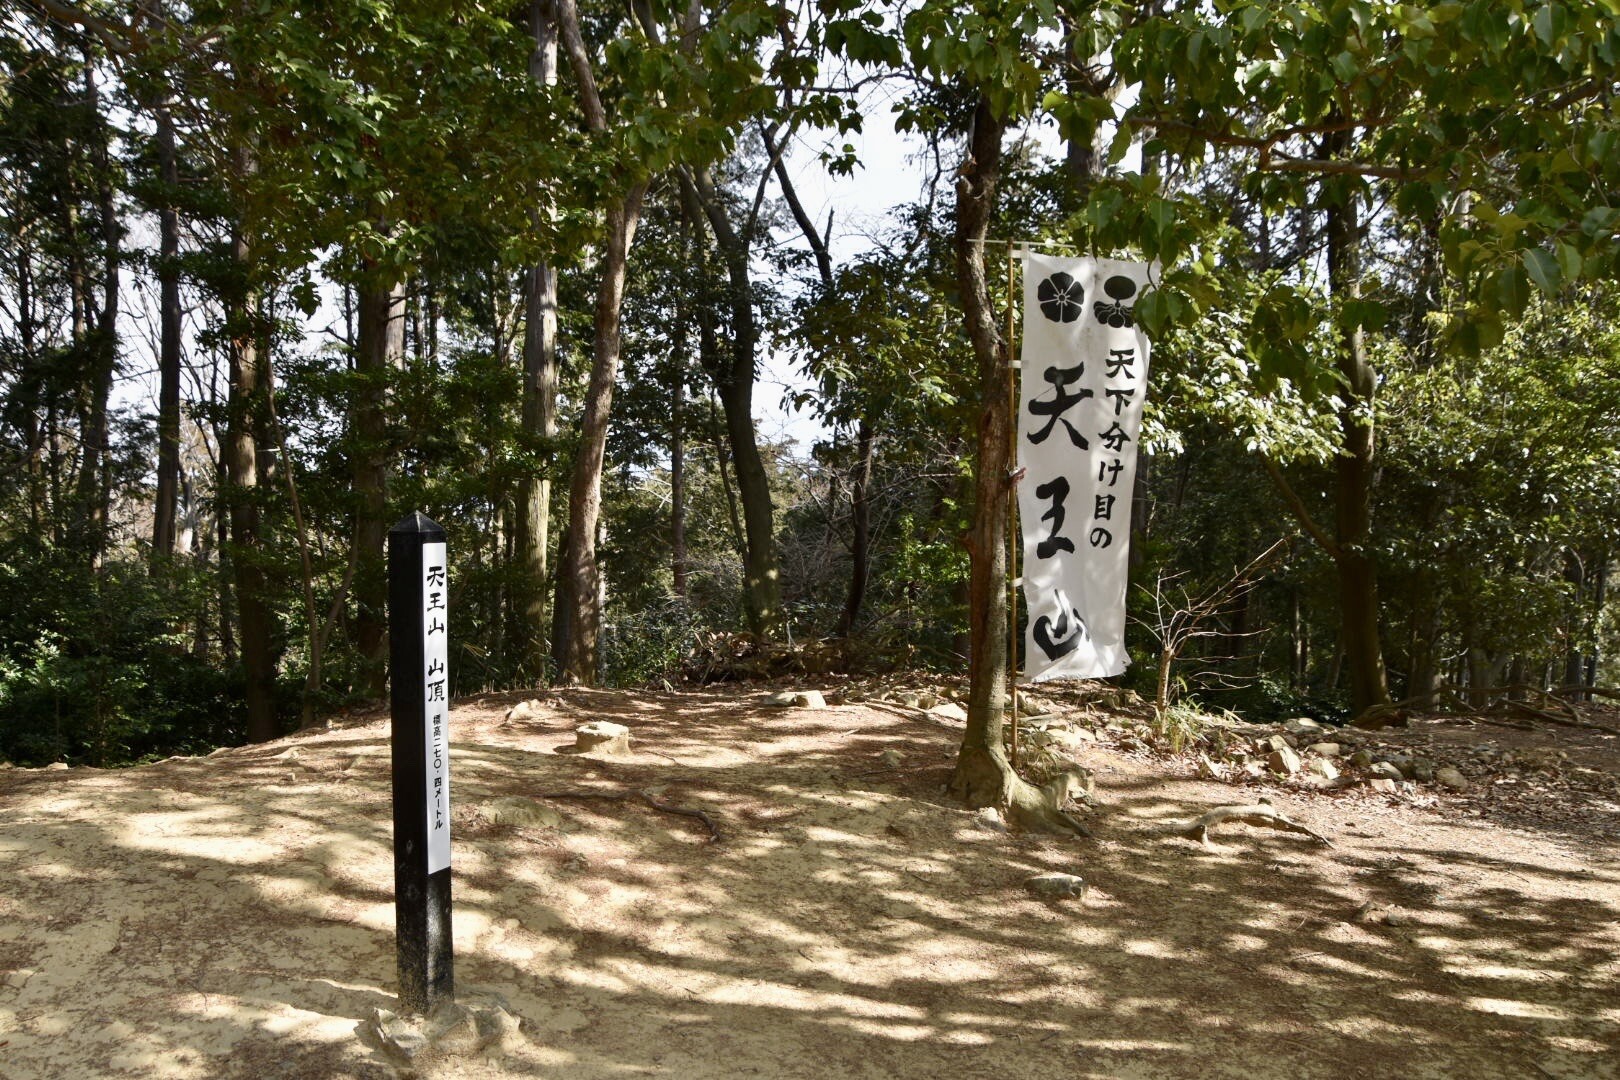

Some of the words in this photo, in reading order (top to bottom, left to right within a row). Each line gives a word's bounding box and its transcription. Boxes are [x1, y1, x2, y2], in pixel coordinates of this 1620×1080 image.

[1026, 361, 1094, 660] 天王山
[1090, 348, 1134, 548] 天下分け目の
[427, 566, 445, 635] 天王山
[428, 658, 445, 702] 山頂
